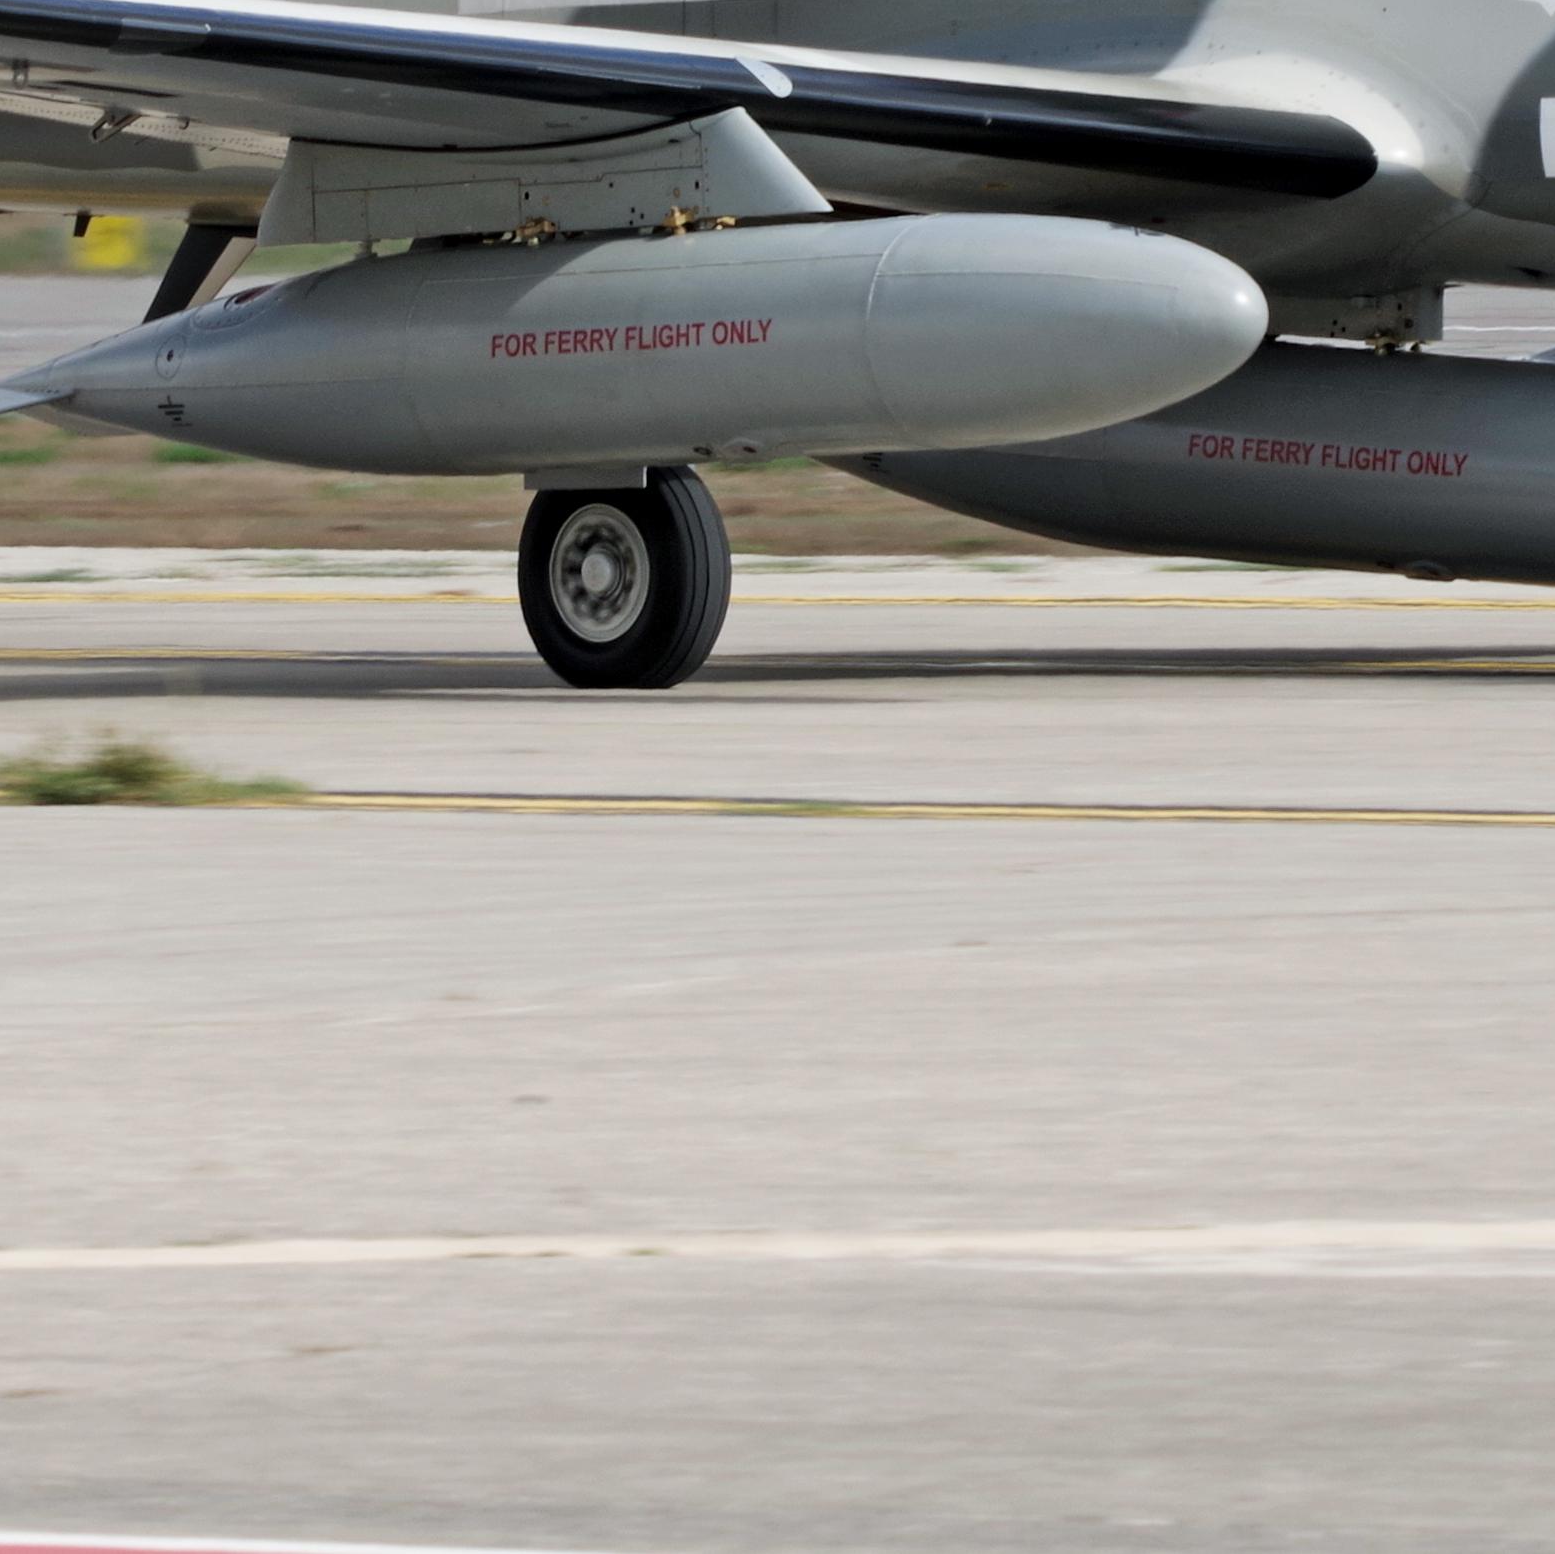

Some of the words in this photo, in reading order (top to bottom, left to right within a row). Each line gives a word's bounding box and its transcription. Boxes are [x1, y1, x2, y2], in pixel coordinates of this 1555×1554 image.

[490, 333, 538, 358] FOR
[543, 327, 618, 354] FERRY
[623, 322, 706, 350] FLIGHT
[711, 318, 772, 345] ONLY
[1187, 434, 1235, 459] FOR
[1241, 438, 1315, 466] FERRY
[1320, 444, 1402, 472] FLIGHT
[1406, 450, 1468, 477] ONLY
